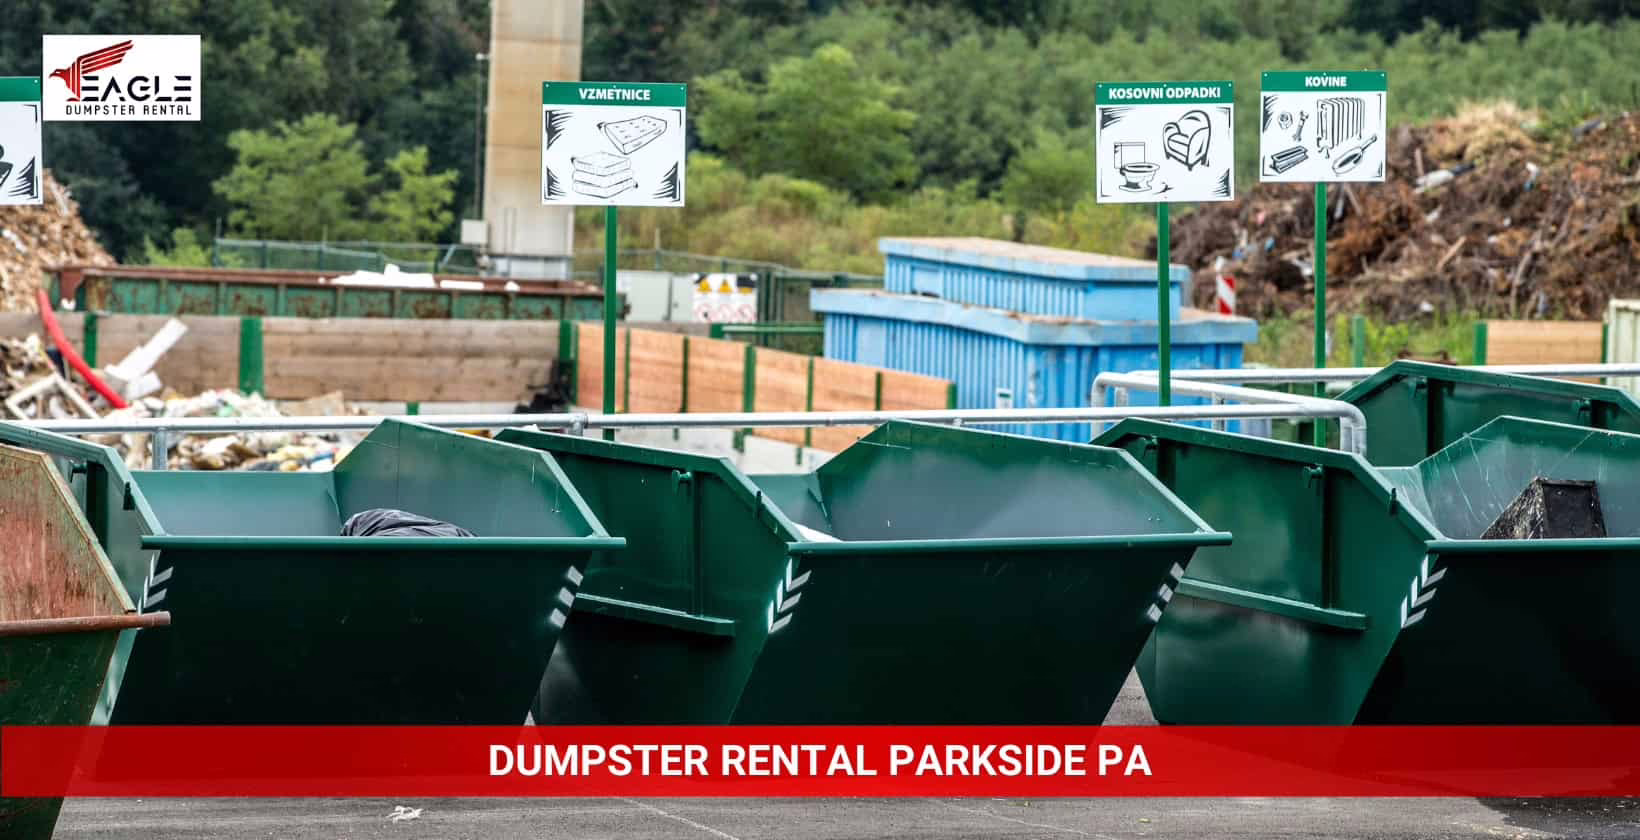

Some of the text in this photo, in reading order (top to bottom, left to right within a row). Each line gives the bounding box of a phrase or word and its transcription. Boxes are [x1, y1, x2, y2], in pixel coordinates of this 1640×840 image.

[1305, 76, 1347, 87] KOVINE
[578, 88, 651, 101] VZMETNICE
[1108, 87, 1221, 99] KOSOVNI ODPADKI
